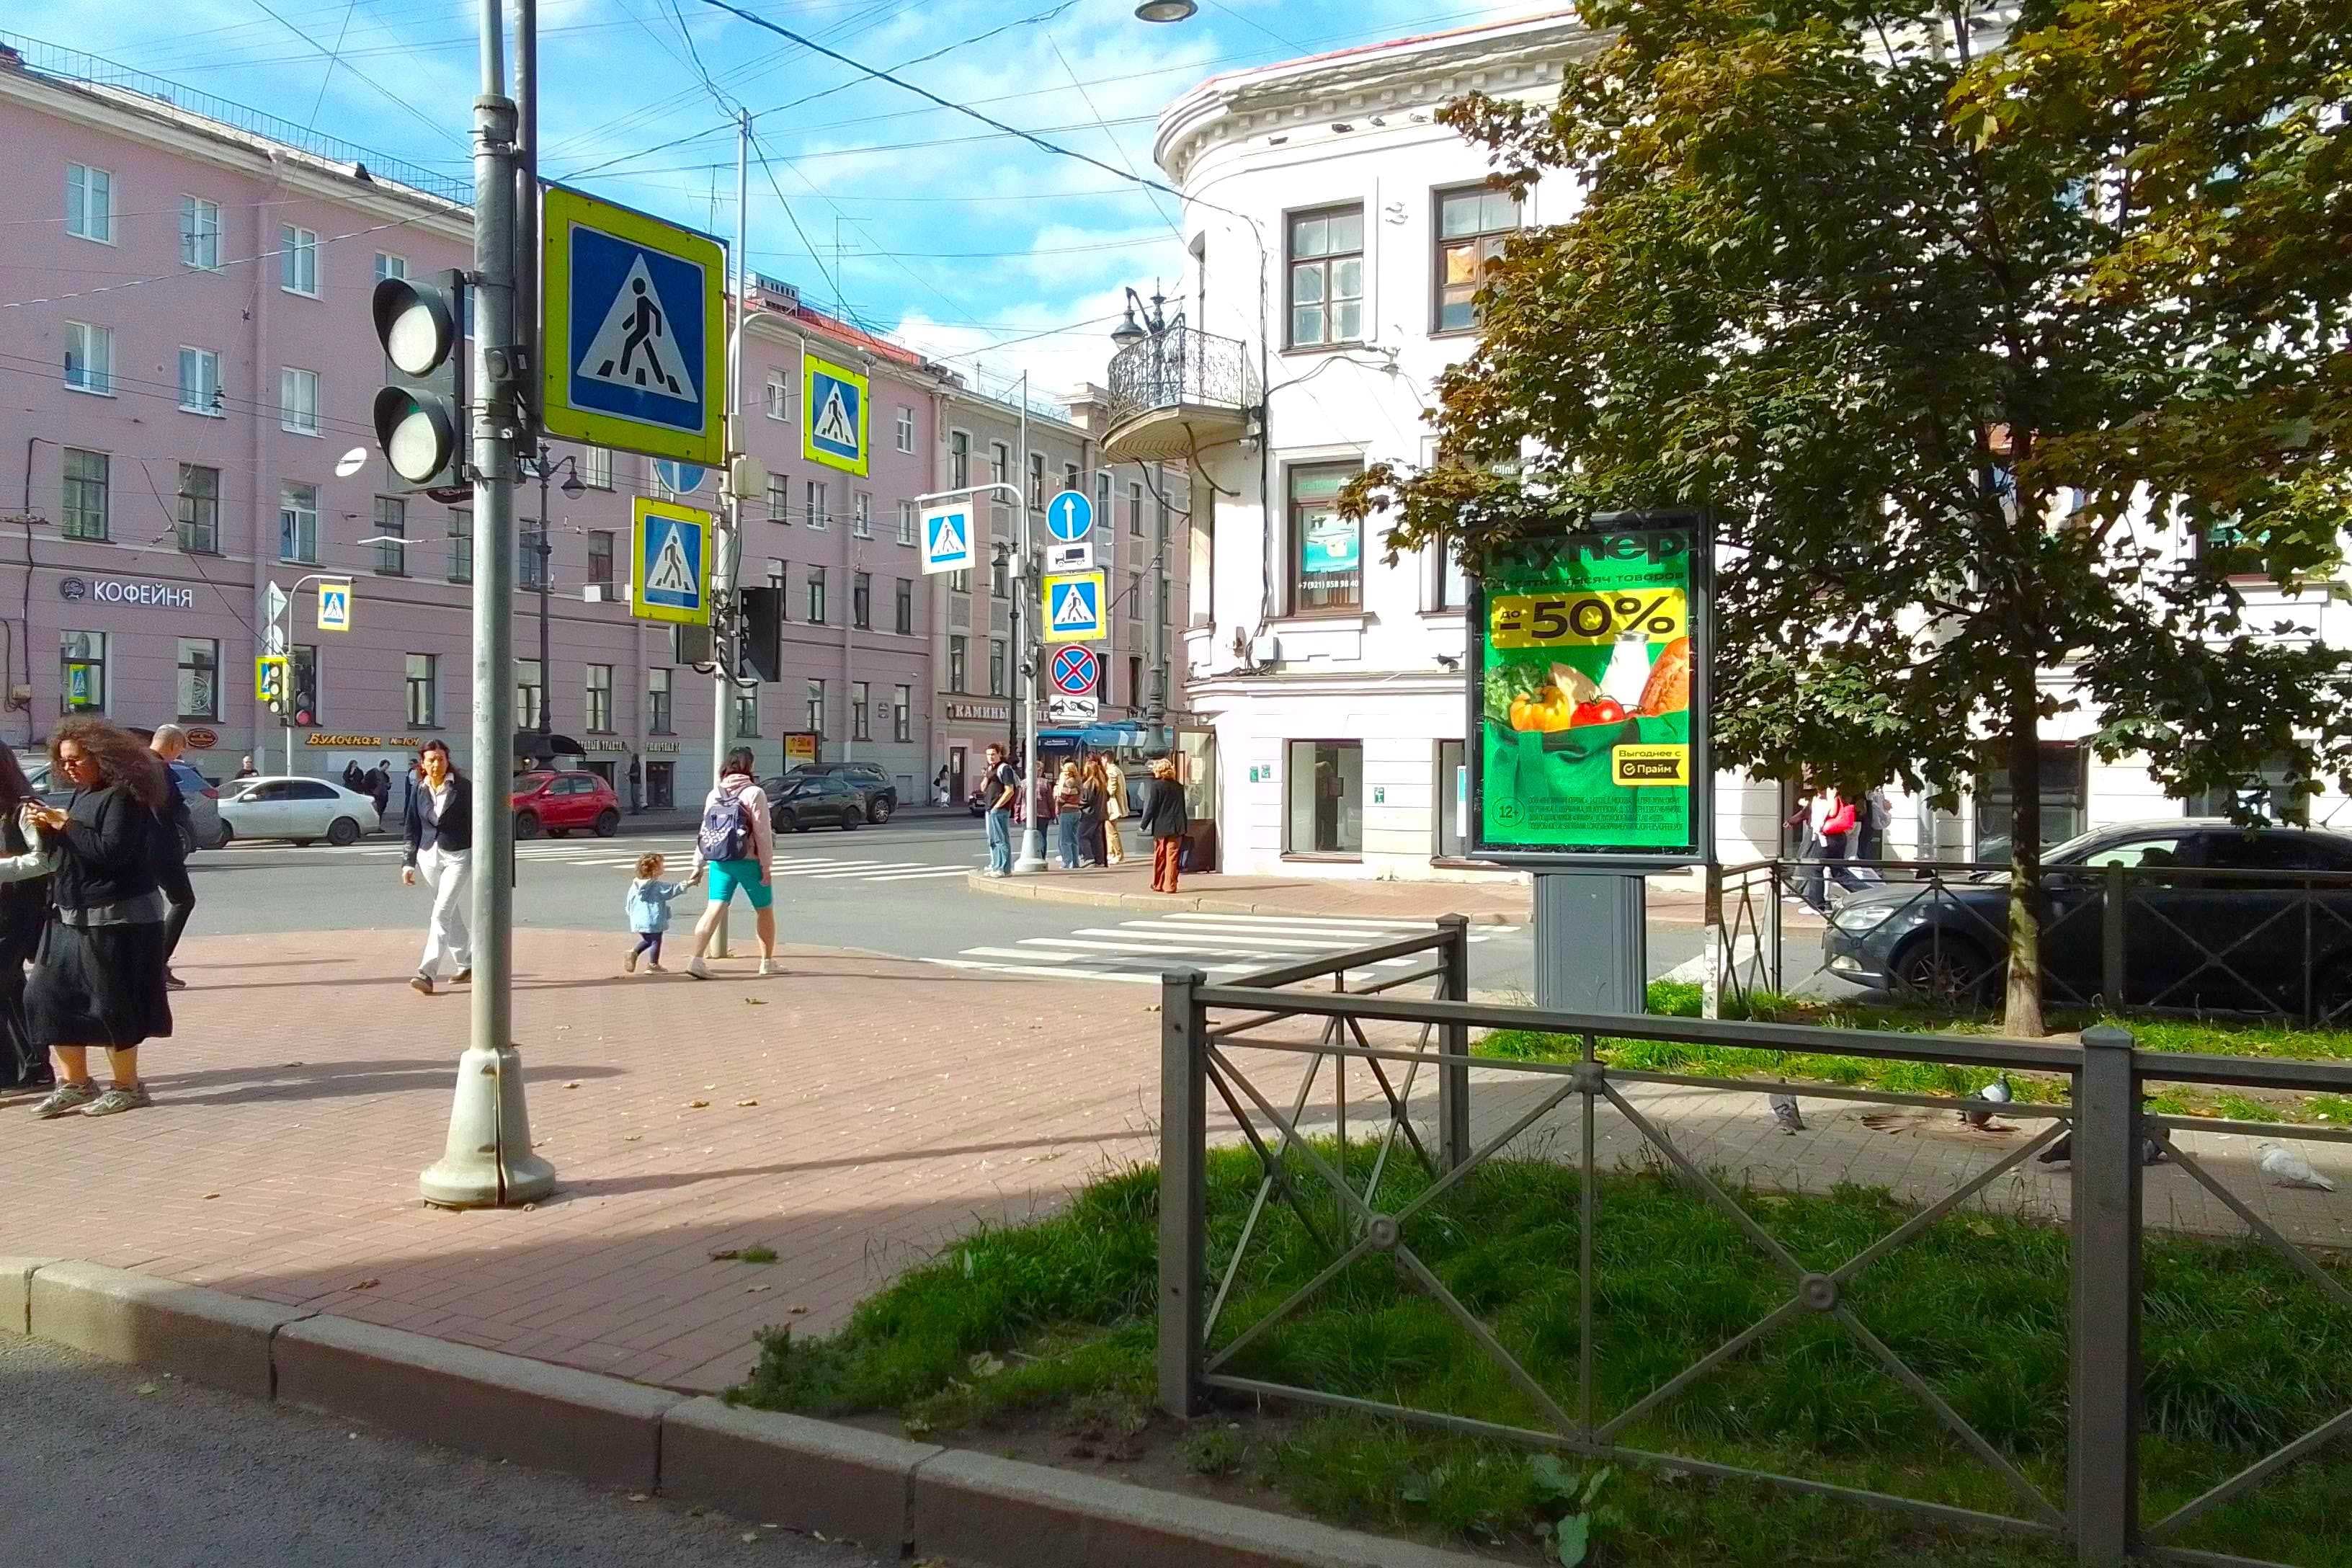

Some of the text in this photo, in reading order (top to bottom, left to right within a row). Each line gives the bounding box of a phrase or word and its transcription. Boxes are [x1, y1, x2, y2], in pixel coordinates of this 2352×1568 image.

[1616, 572, 1684, 583] товаров
[1298, 581, 1306, 589] +7
[1307, 581, 1324, 589] (921)
[94, 581, 192, 607] КОФЕЙНЯ
[1500, 610, 1520, 619] до
[955, 705, 1009, 719] КАМИНЫ
[306, 733, 380, 745] Булочная
[1637, 764, 1671, 775] Прайм
[1500, 806, 1519, 819] 12+
